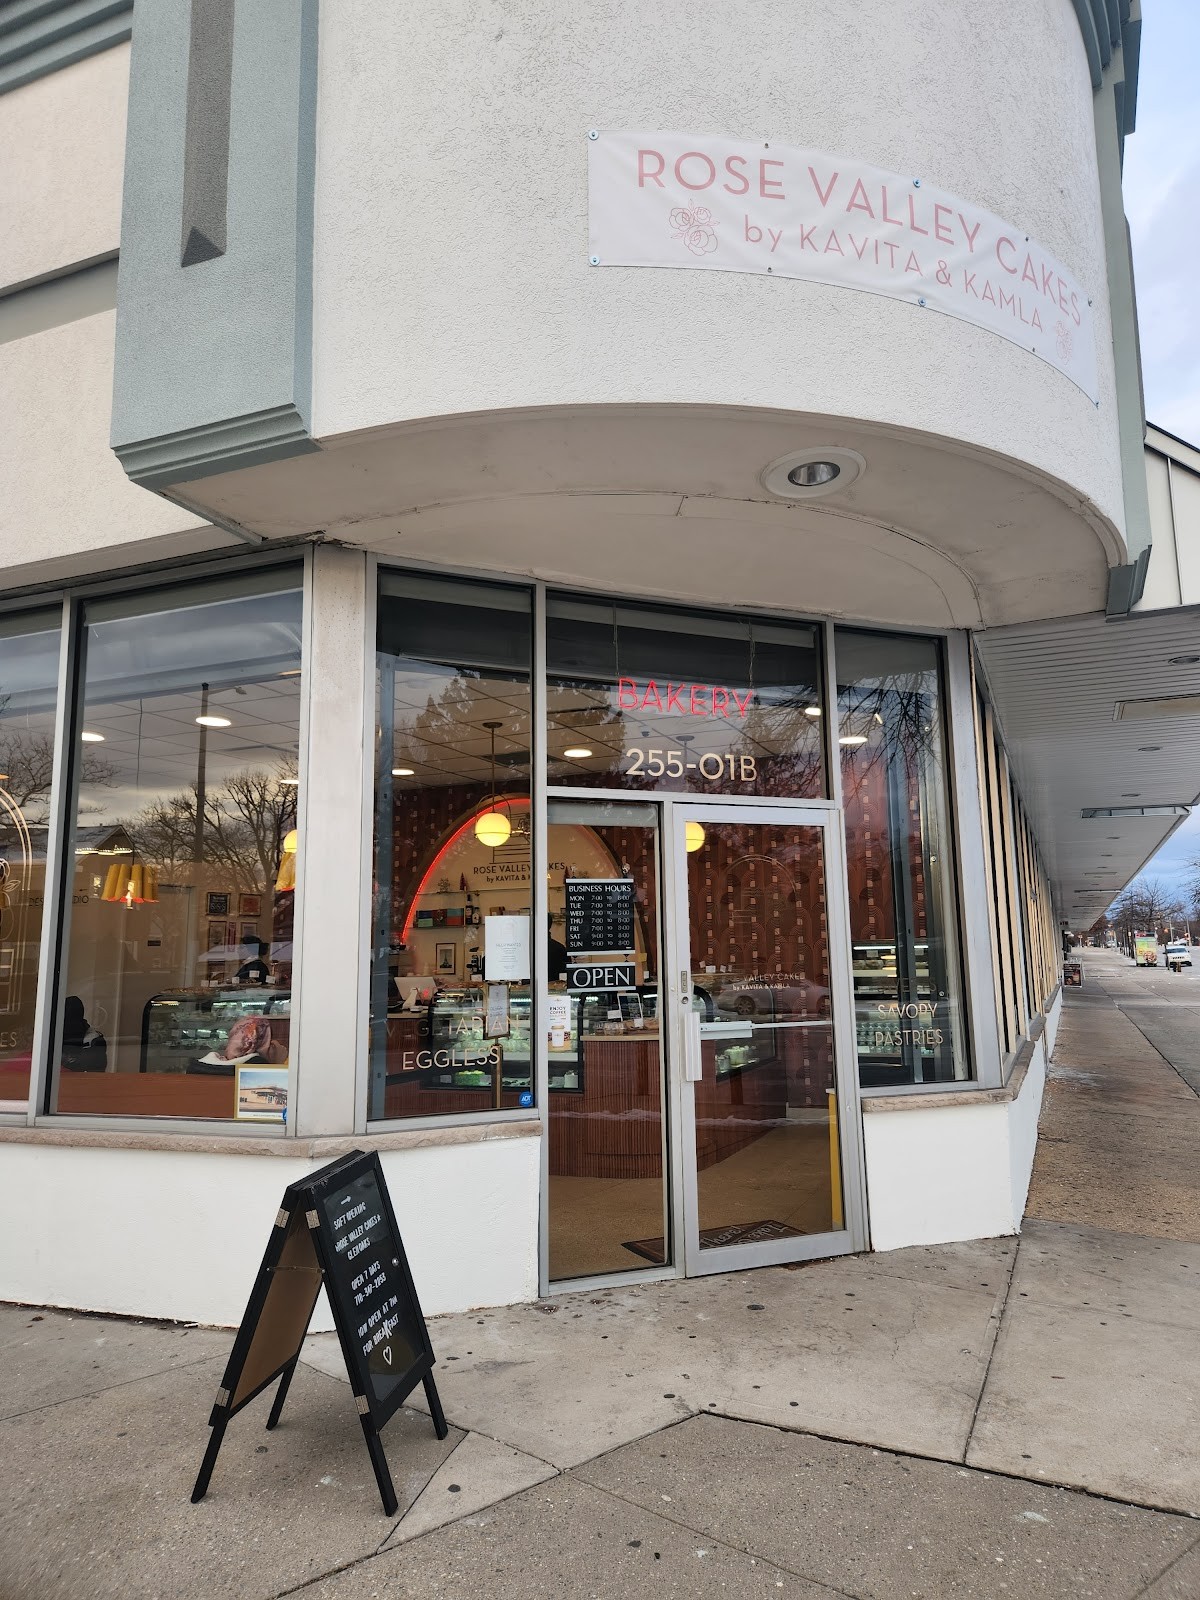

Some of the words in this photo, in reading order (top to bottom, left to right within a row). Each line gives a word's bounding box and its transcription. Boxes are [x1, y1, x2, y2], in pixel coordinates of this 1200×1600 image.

[638, 149, 786, 200] ROSE
[808, 166, 982, 253] VALLEY
[996, 236, 1081, 326] CAKES
[744, 214, 783, 253] by
[800, 223, 923, 278] KAVITA
[936, 259, 953, 288] &
[964, 266, 1043, 332] KAMLA
[617, 676, 753, 718] BAKERY
[473, 865, 497, 875] ROSE
[548, 862, 565, 871] KES
[486, 875, 494, 883] by
[495, 874, 520, 882] KAVITA
[568, 884, 603, 893] BUSINESS
[604, 884, 632, 892] HOURS
[572, 967, 630, 987] OPEN
[877, 1002, 938, 1020] SAVORY
[875, 1028, 944, 1047] PASTRIES
[402, 1045, 500, 1070] EGGLESS
[333, 1214, 347, 1230] SOFT
[347, 1224, 364, 1243] VALLEY
[351, 1273, 365, 1291] OPEN
[363, 1270, 369, 1280] 7
[368, 1260, 381, 1276] DAYS
[367, 1309, 382, 1328] OPEN
[382, 1301, 389, 1315] AT
[362, 1339, 374, 1357] FOR
[372, 1313, 399, 1346] BREAKFAST
